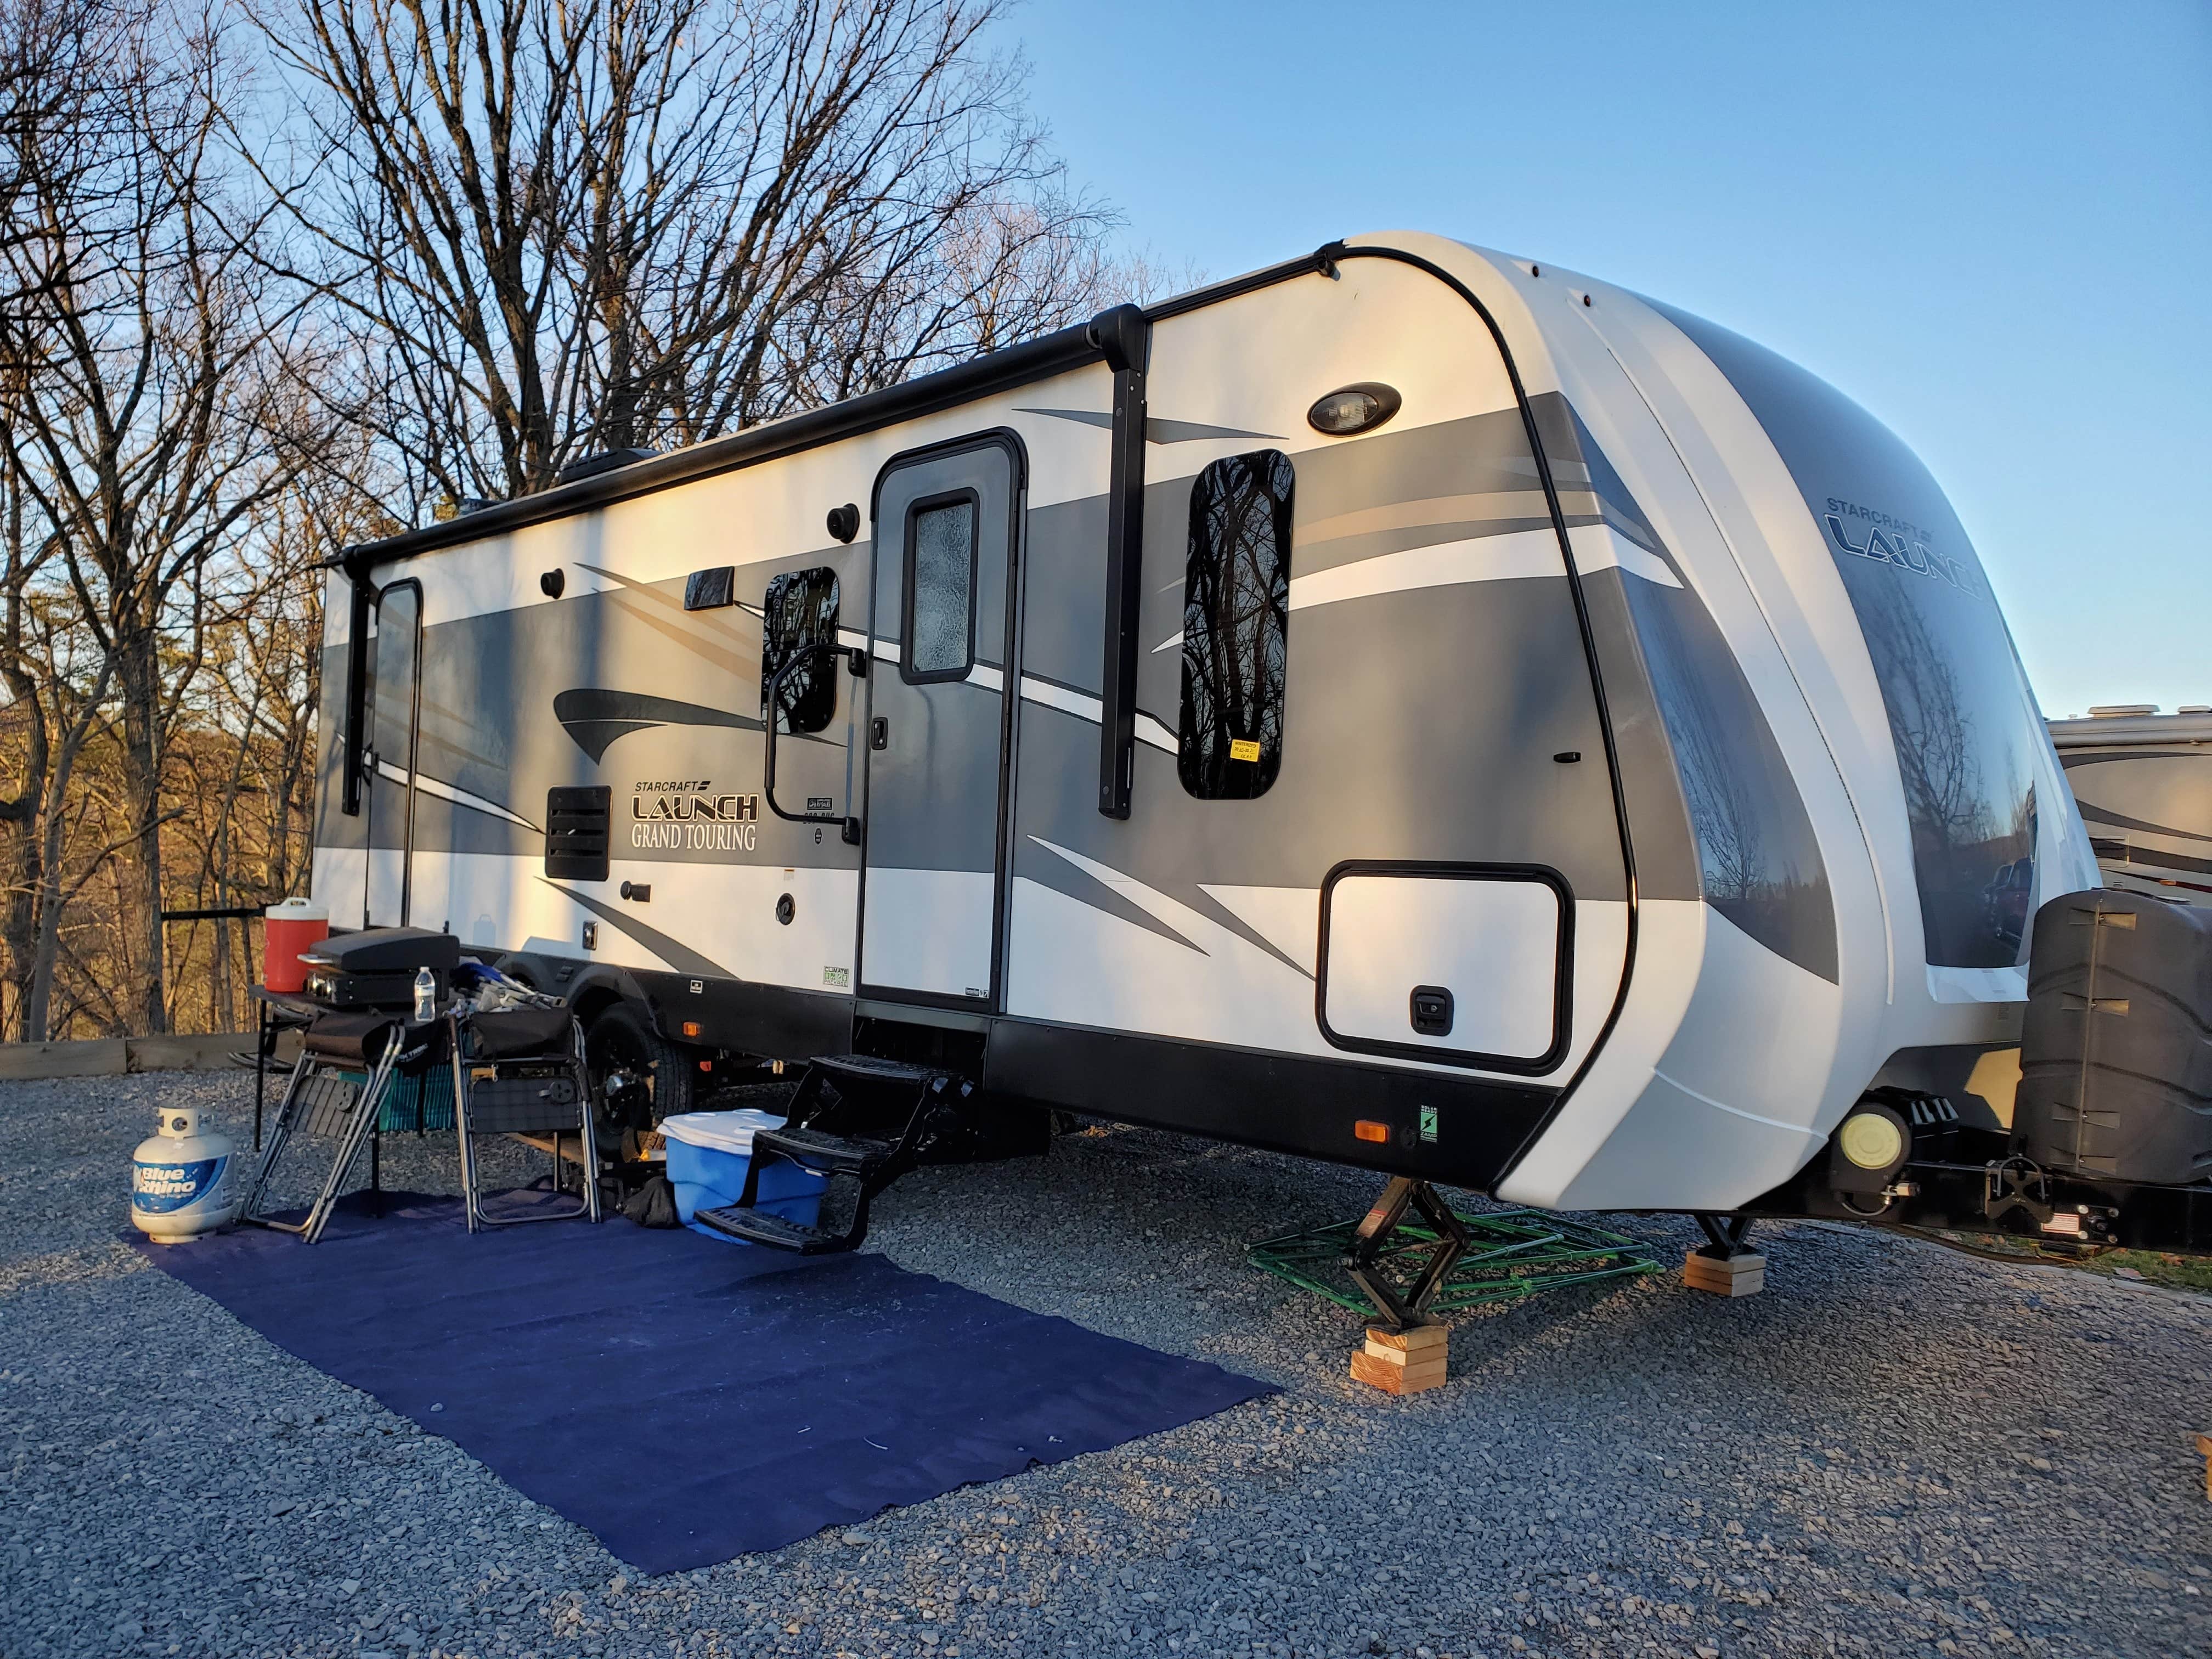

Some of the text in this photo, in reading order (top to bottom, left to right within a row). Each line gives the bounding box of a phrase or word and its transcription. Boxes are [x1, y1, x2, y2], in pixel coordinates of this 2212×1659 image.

[1827, 497, 1922, 538] STARCRAFT
[1824, 512, 1982, 600] LAUNC
[635, 781, 698, 792] STARCRAFT
[631, 794, 759, 822] LAUNCH
[631, 823, 757, 851] GRAND TOURING
[139, 1180, 196, 1195] Rhino
[143, 1167, 185, 1181] Blue
